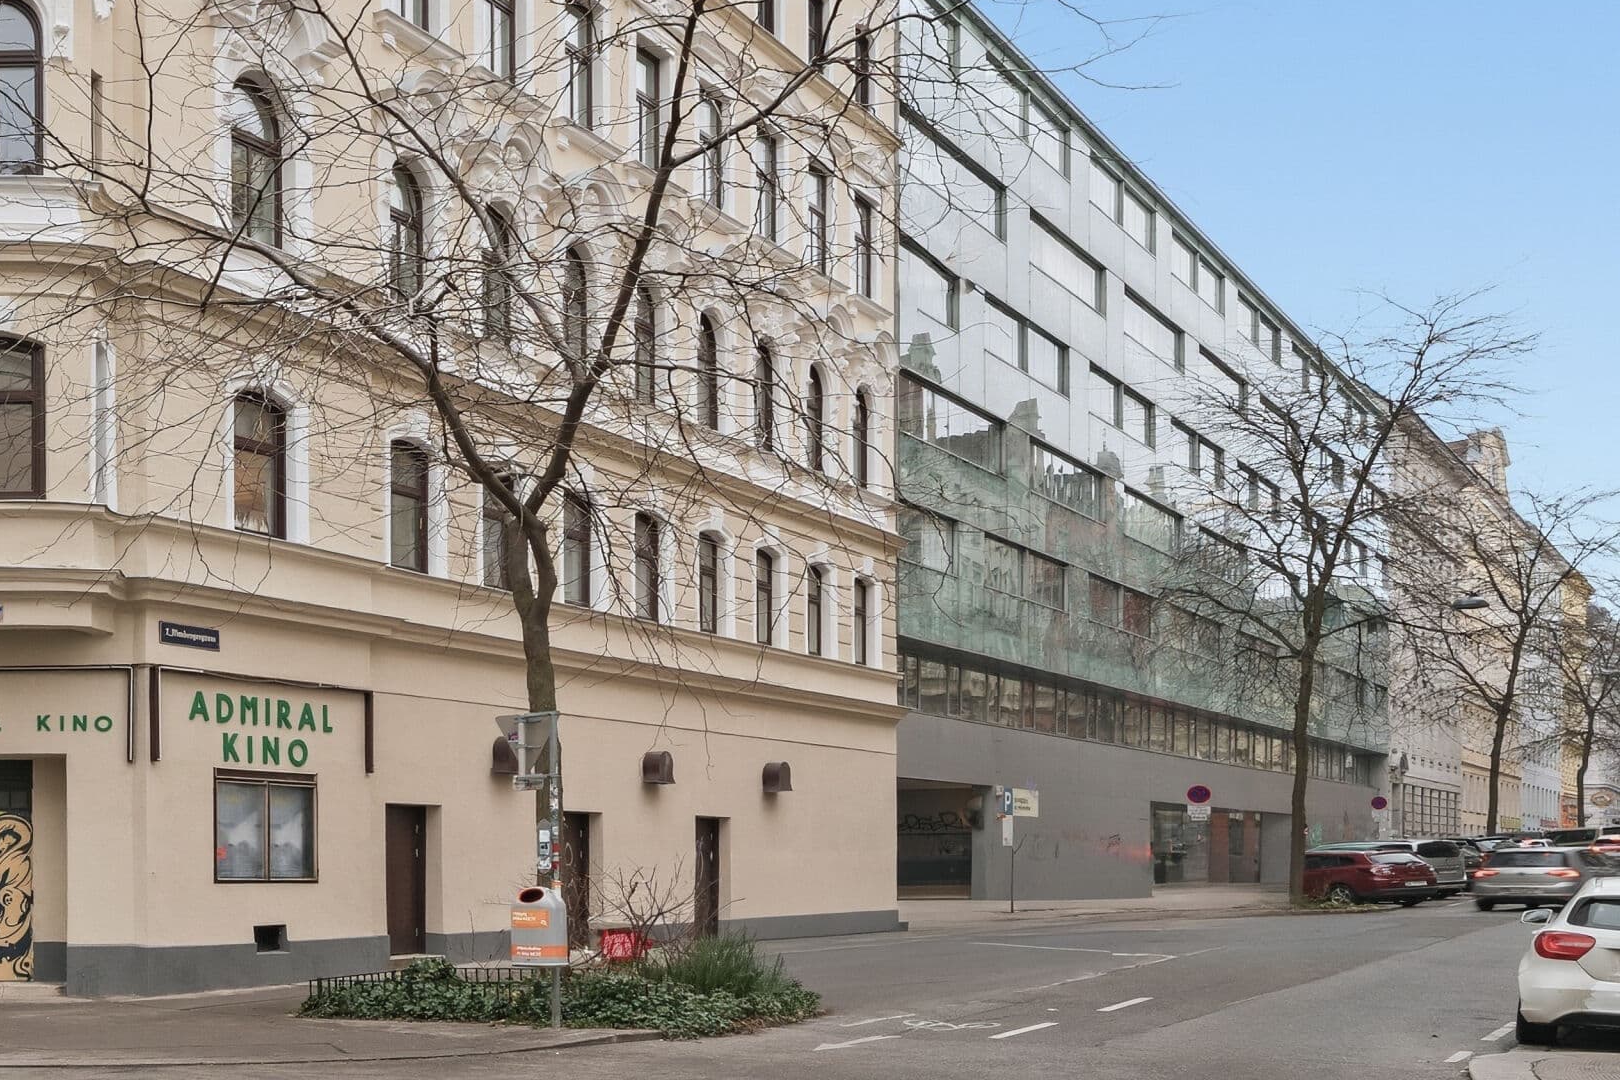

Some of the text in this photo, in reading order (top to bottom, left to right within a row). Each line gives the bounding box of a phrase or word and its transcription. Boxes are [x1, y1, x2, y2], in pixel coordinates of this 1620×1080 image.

[36, 715, 113, 732] KINO
[189, 691, 334, 733] ADMIRAL
[222, 732, 308, 768] KINO
